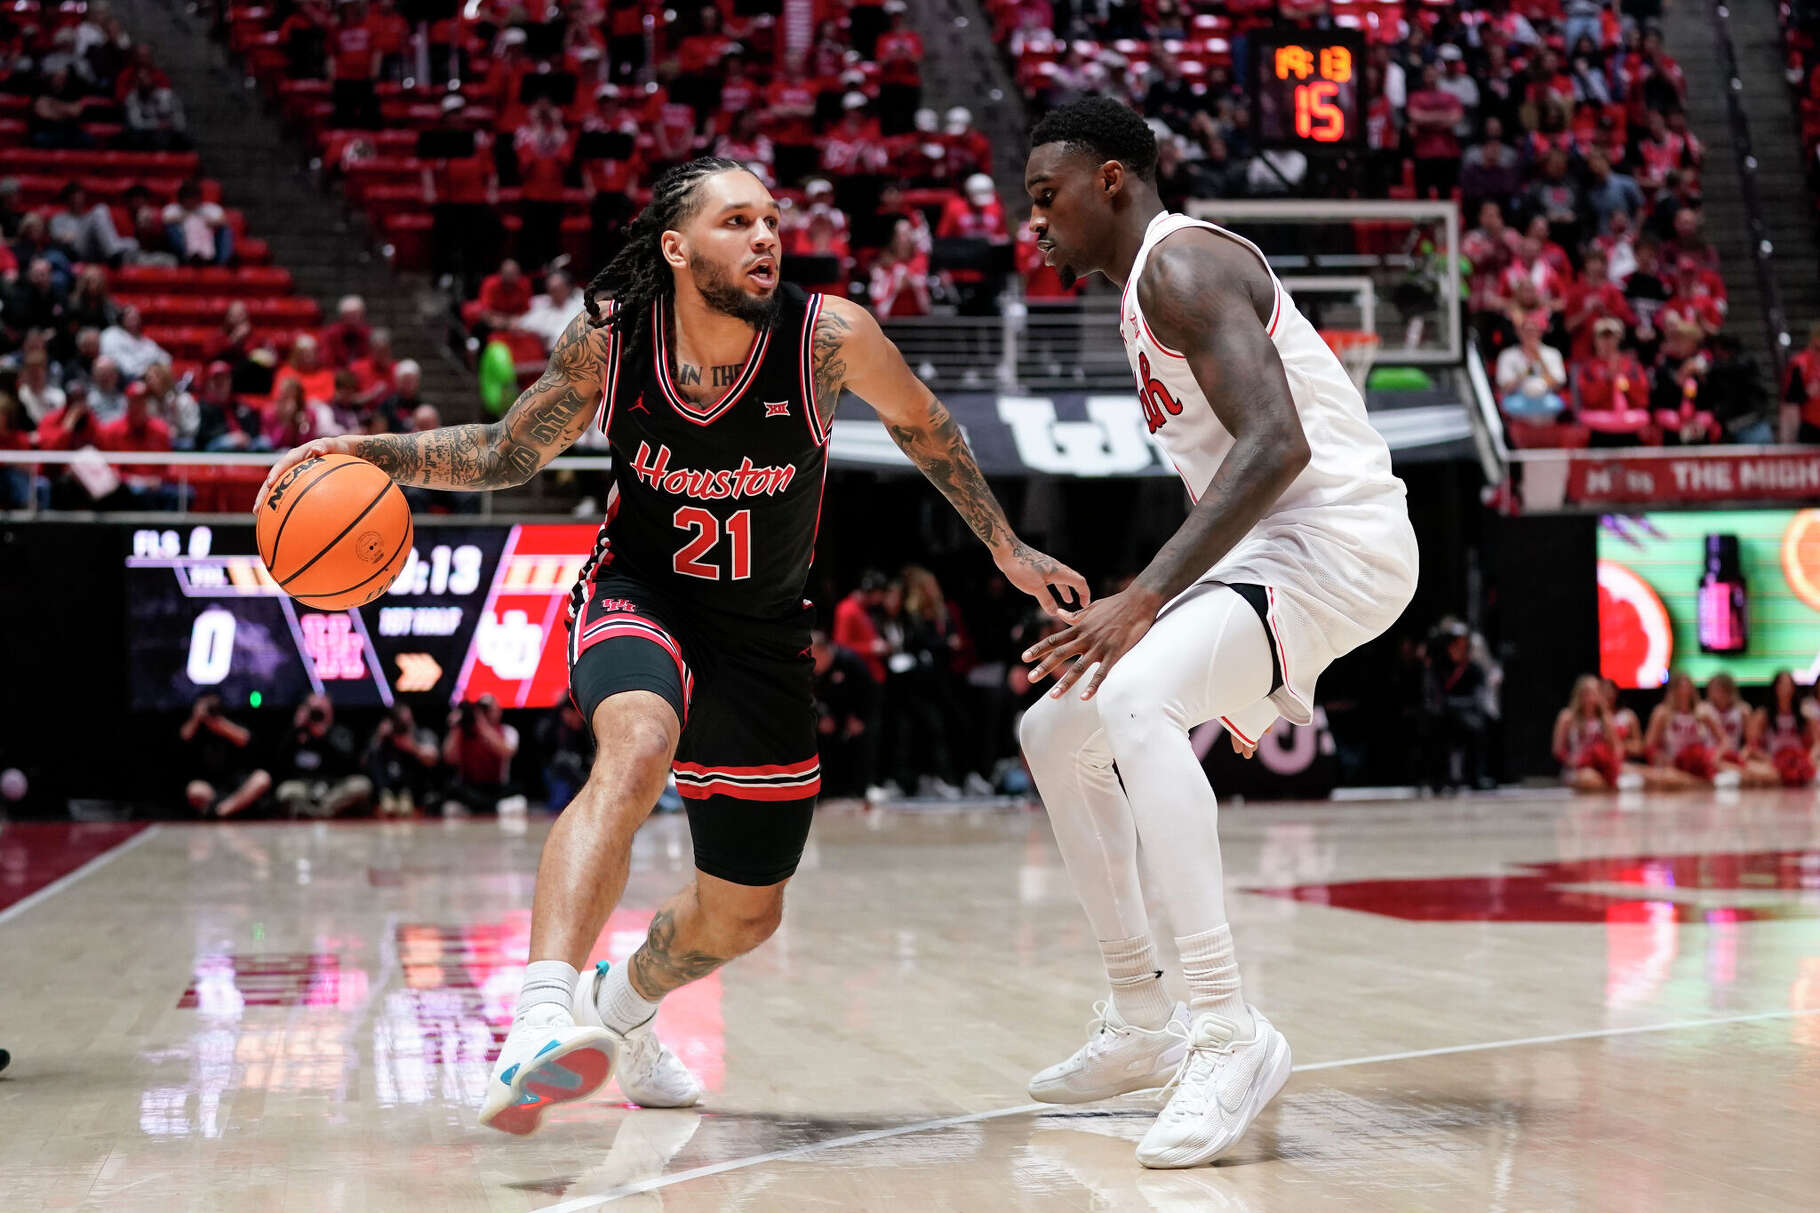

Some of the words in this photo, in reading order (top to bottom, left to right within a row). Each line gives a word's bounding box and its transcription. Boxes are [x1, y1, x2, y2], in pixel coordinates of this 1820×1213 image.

[1294, 81, 1345, 142] 15
[679, 363, 703, 385] IN
[267, 456, 327, 511] NCAA
[630, 440, 796, 500] Houston
[1671, 461, 1733, 492] THE
[673, 505, 751, 581] 21
[187, 609, 237, 685] 0
